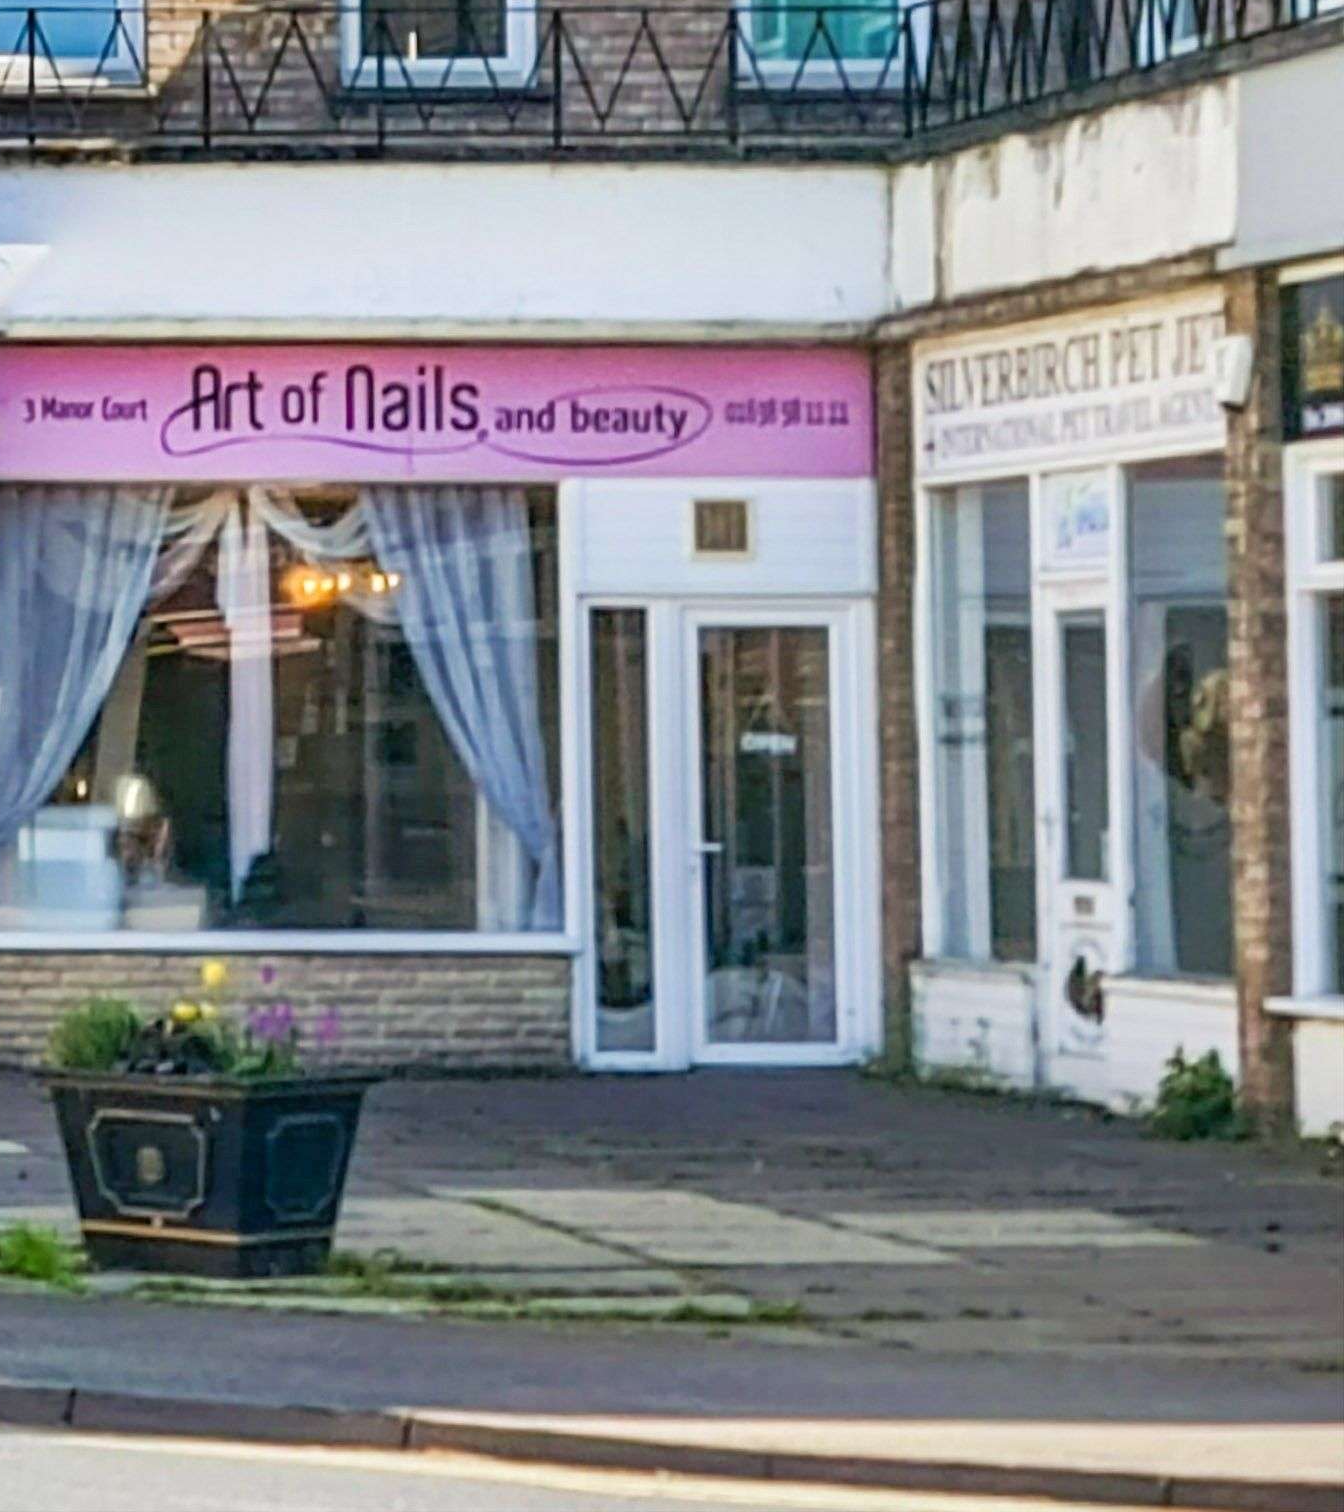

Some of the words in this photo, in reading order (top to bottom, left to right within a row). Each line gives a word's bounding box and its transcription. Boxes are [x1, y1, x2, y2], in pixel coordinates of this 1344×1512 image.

[192, 364, 264, 431] Art
[280, 372, 329, 424] of
[345, 364, 480, 433] Nails
[494, 402, 556, 434] and
[570, 400, 688, 441] beauty
[924, 334, 1101, 415] SILVERBIRCH
[1110, 322, 1162, 386] PET
[23, 398, 36, 422] 3
[41, 397, 95, 421] Manor
[102, 396, 148, 422] Court
